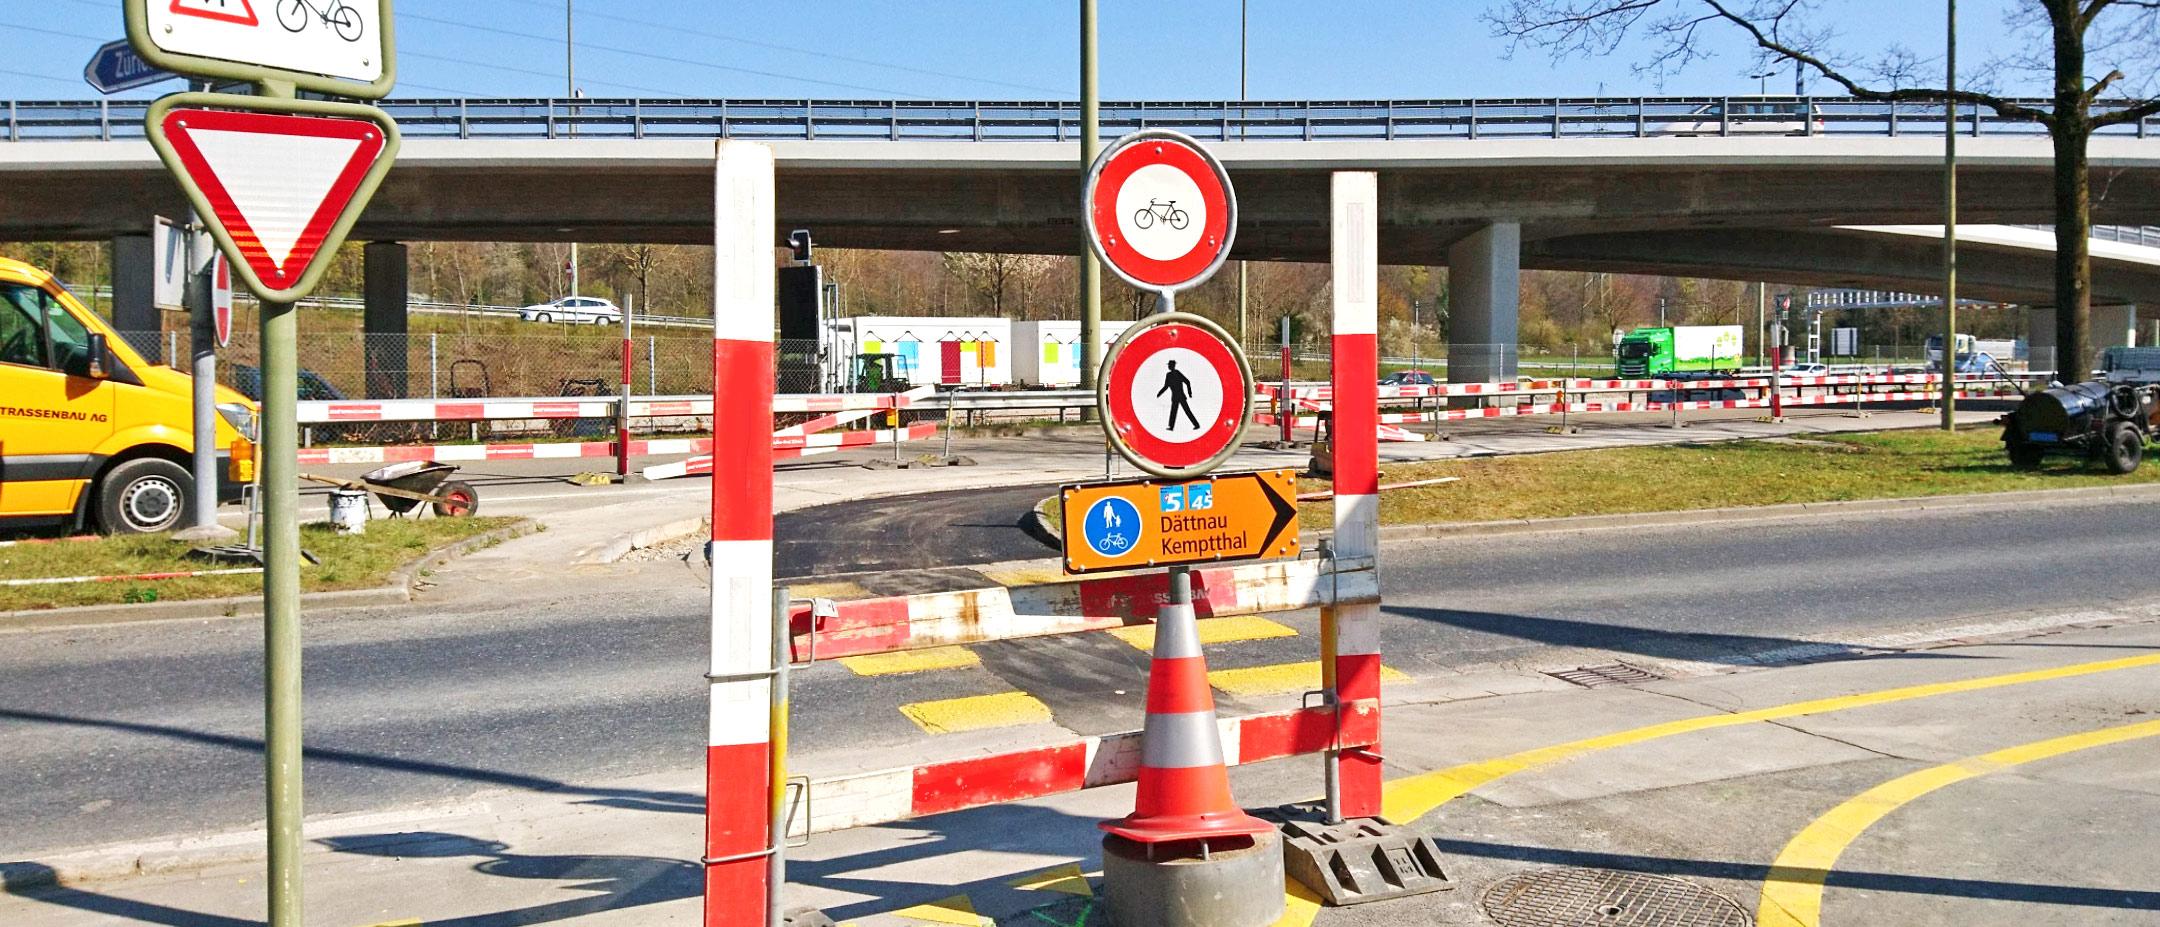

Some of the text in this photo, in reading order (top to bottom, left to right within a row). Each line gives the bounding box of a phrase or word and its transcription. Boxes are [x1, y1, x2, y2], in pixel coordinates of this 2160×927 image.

[90, 413, 107, 423] AG
[1166, 492, 1213, 512] 5 45
[1161, 515, 1227, 533] Dättnau
[1162, 530, 1247, 556] Kemptthal
